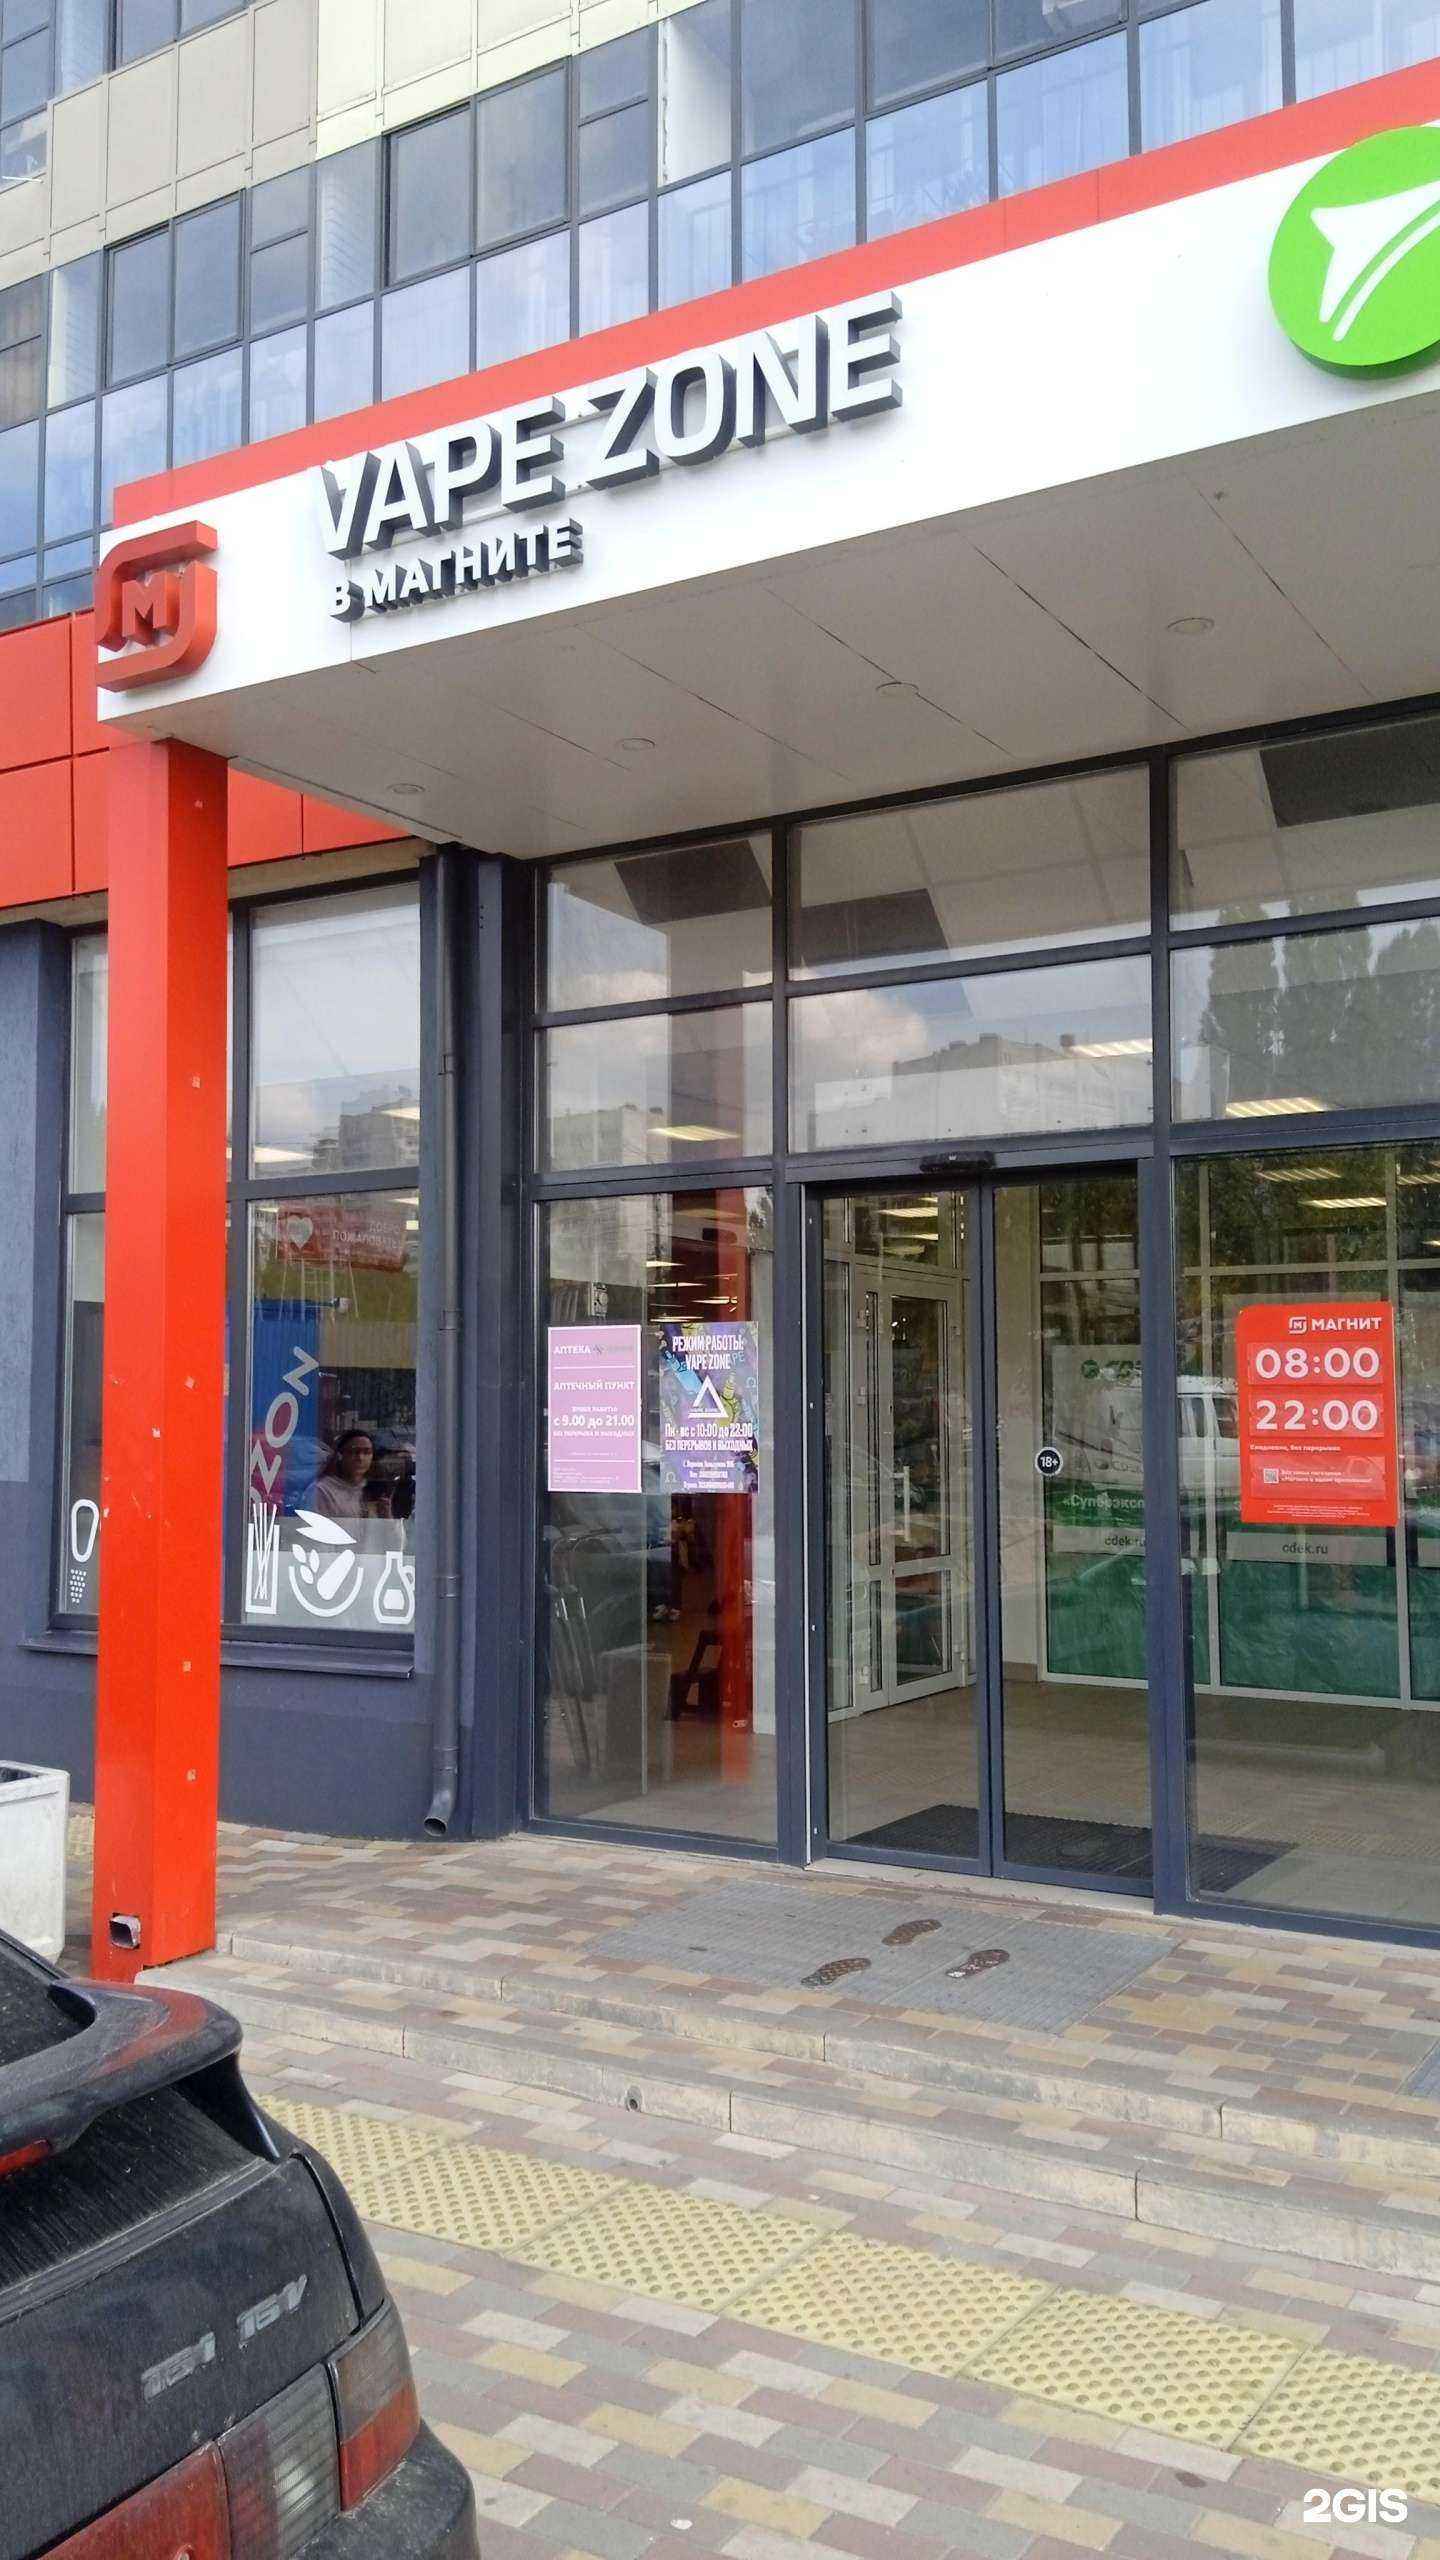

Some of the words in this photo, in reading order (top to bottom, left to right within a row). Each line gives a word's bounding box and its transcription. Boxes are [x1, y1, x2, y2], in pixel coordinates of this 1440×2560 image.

[317, 394, 566, 560] VAPE
[554, 290, 902, 490] ZONE
[363, 517, 584, 613] МАГНИТЕ
[1311, 1317, 1382, 1331] МАГНИТ
[553, 1346, 591, 1354] АПТЕКА
[672, 1335, 705, 1352] РЕЖИМ
[706, 1334, 744, 1351] РАБОТЫ:
[686, 1354, 708, 1370] VAPE
[708, 1354, 731, 1370] ZONE
[1256, 1347, 1380, 1379] 08:00
[553, 1380, 603, 1391] АПТЕЧНЫЙ
[604, 1381, 635, 1391] ПУНКТ
[587, 1417, 603, 1429] до
[605, 1414, 635, 1426] 21.00
[1256, 1400, 1378, 1431] 22:00
[696, 1423, 717, 1438] 10:00
[718, 1426, 729, 1439] до
[729, 1422, 753, 1437] 22:00
[1040, 1456, 1058, 1467] 18+
[1282, 1541, 1328, 1555] cdek.ru
